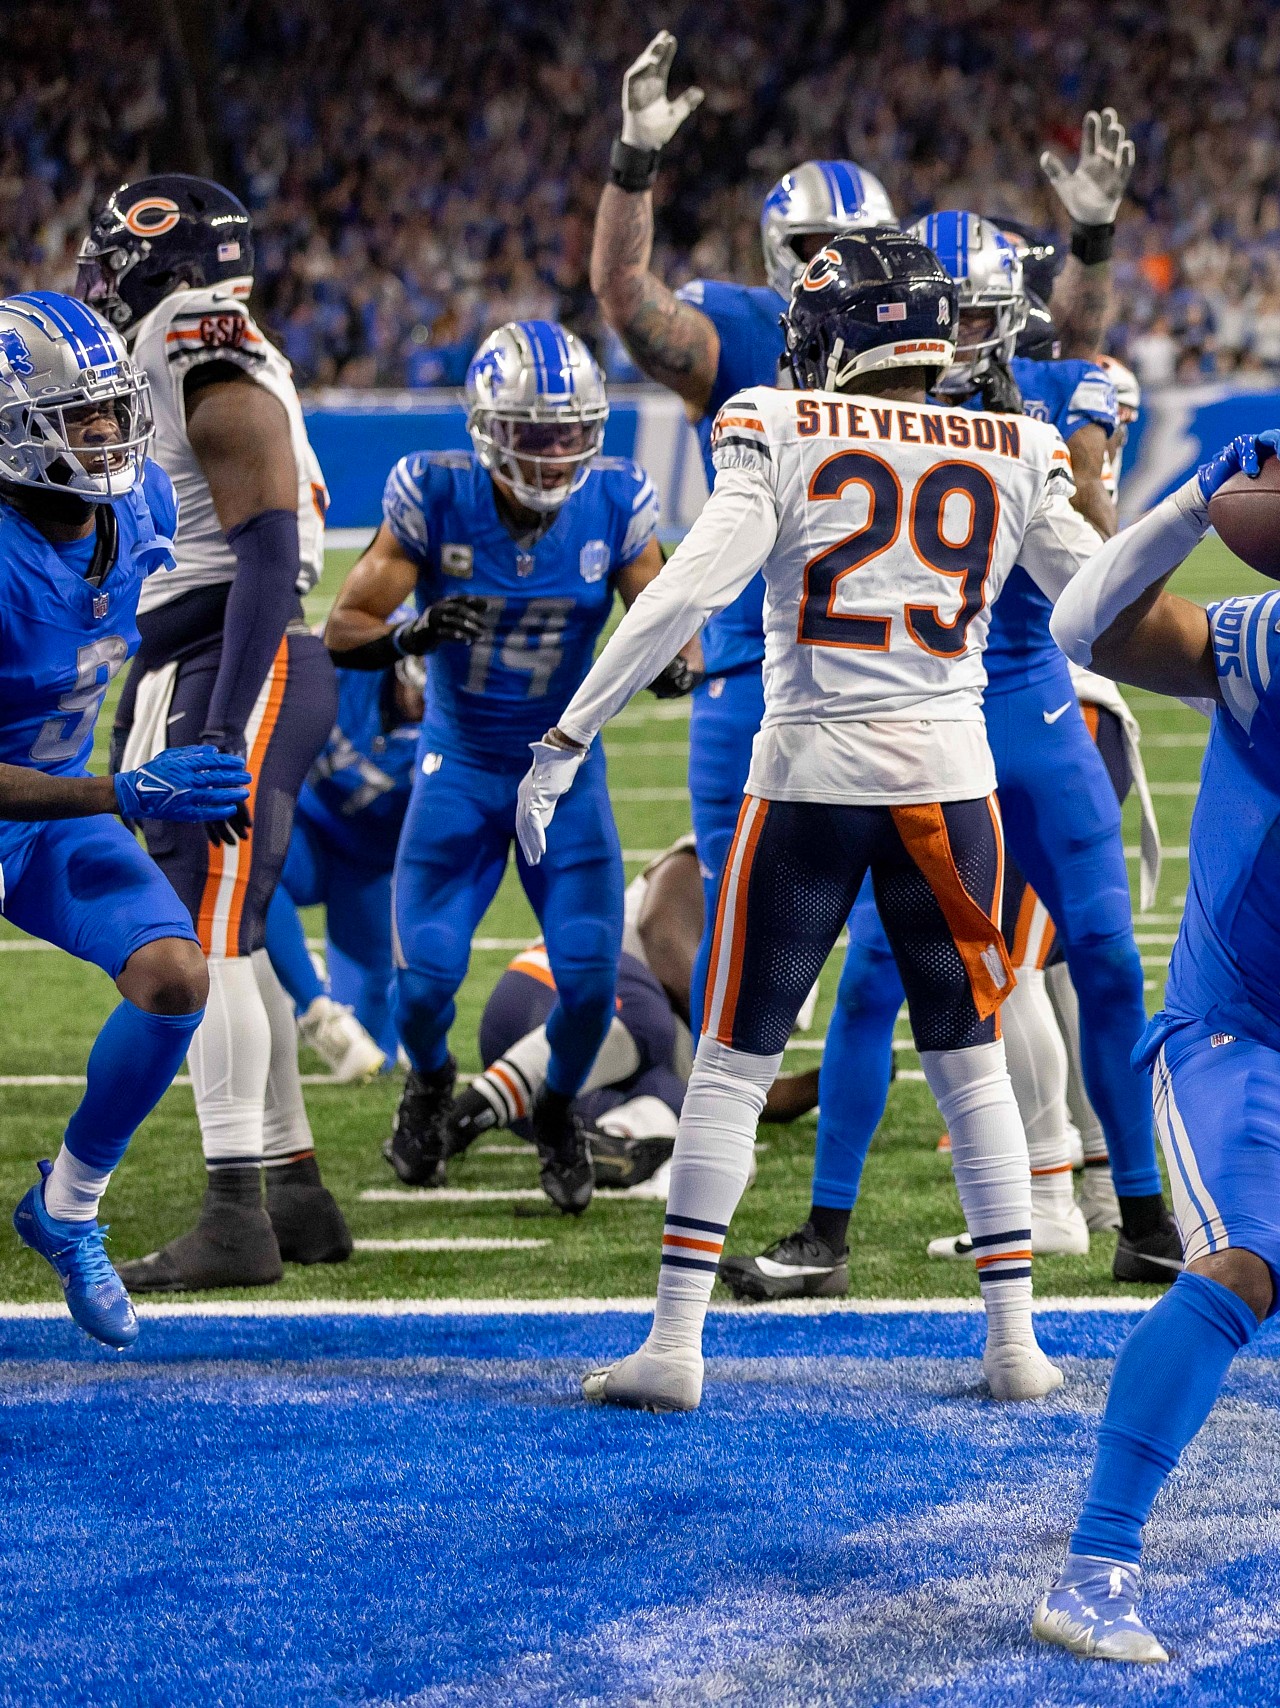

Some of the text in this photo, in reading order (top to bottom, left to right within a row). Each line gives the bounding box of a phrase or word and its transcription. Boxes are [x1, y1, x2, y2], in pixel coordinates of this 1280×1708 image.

[795, 399, 1021, 459] STEVENSON
[797, 449, 1000, 658] 29
[459, 596, 577, 697] 14
